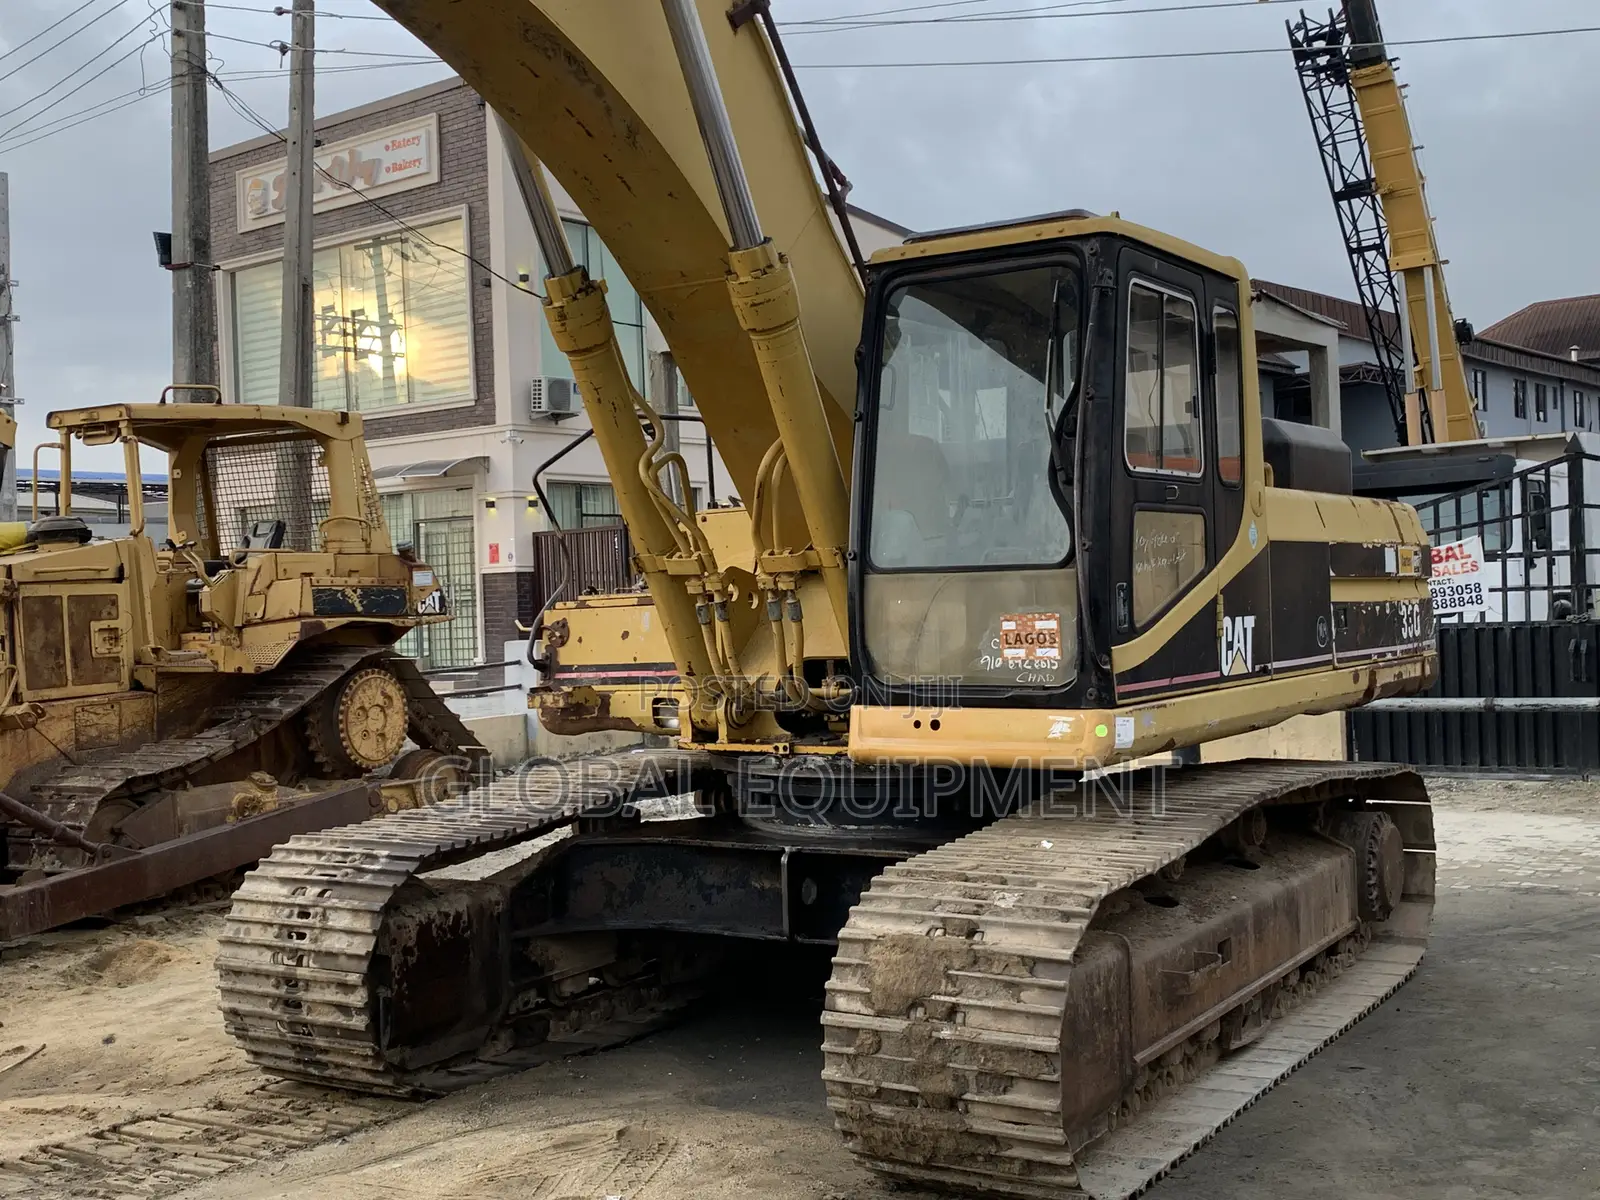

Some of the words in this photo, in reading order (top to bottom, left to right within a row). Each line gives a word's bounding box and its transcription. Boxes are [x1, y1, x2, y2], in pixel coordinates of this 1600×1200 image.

[391, 134, 422, 149] Eatery
[391, 156, 423, 174] Bakery
[1433, 560, 1479, 577] SALES
[418, 590, 440, 614] CAT
[1004, 632, 1057, 646] LAGOS
[1221, 615, 1255, 676] CAT
